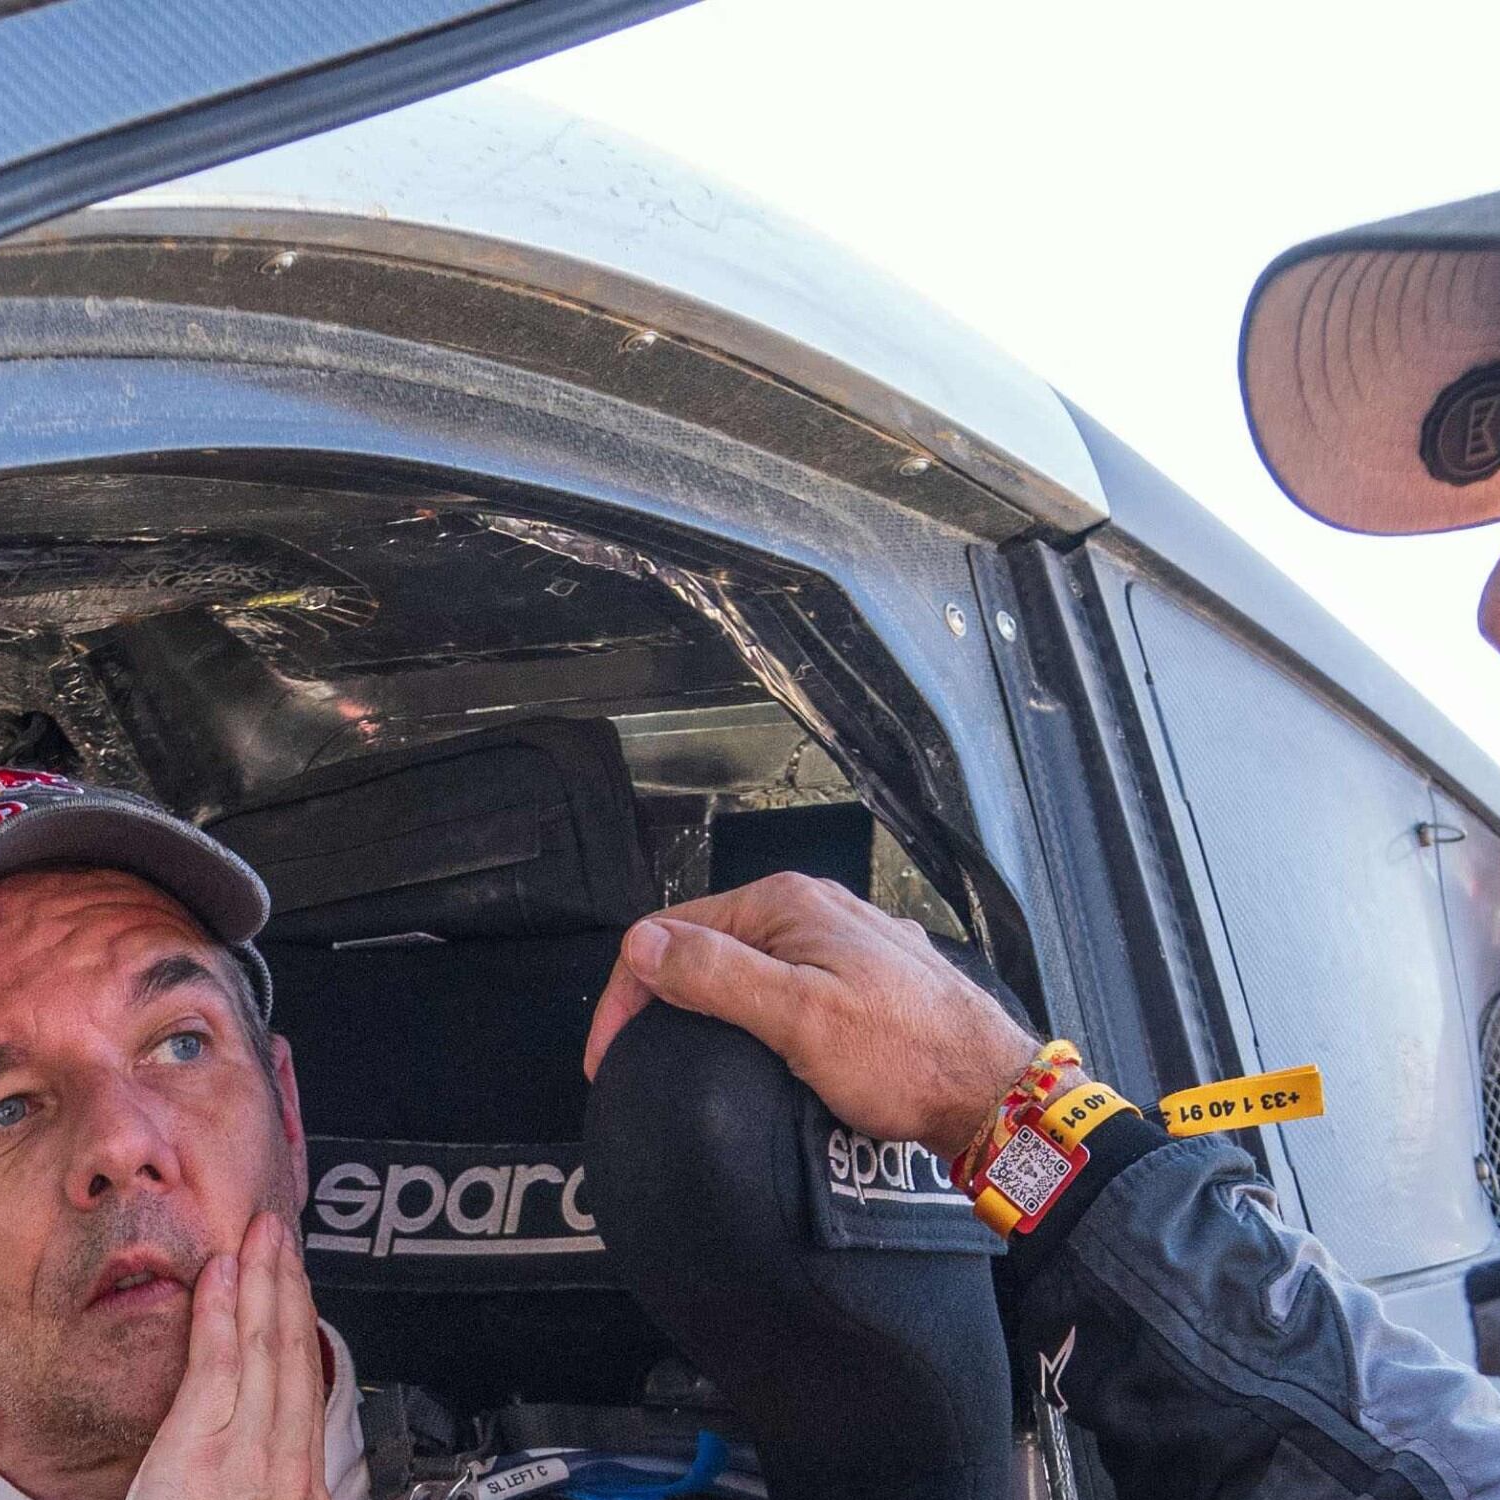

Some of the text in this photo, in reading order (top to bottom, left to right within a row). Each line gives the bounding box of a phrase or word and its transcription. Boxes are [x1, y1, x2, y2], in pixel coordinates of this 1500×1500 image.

[1083, 1094, 1106, 1110] 40
[1208, 1099, 1235, 1118] 40
[1242, 1097, 1253, 1113] 1
[1260, 1091, 1300, 1111] +33
[1061, 1106, 1087, 1129] 91
[1179, 1104, 1203, 1123] 91
[487, 1465, 548, 1494] SL LEFT C
